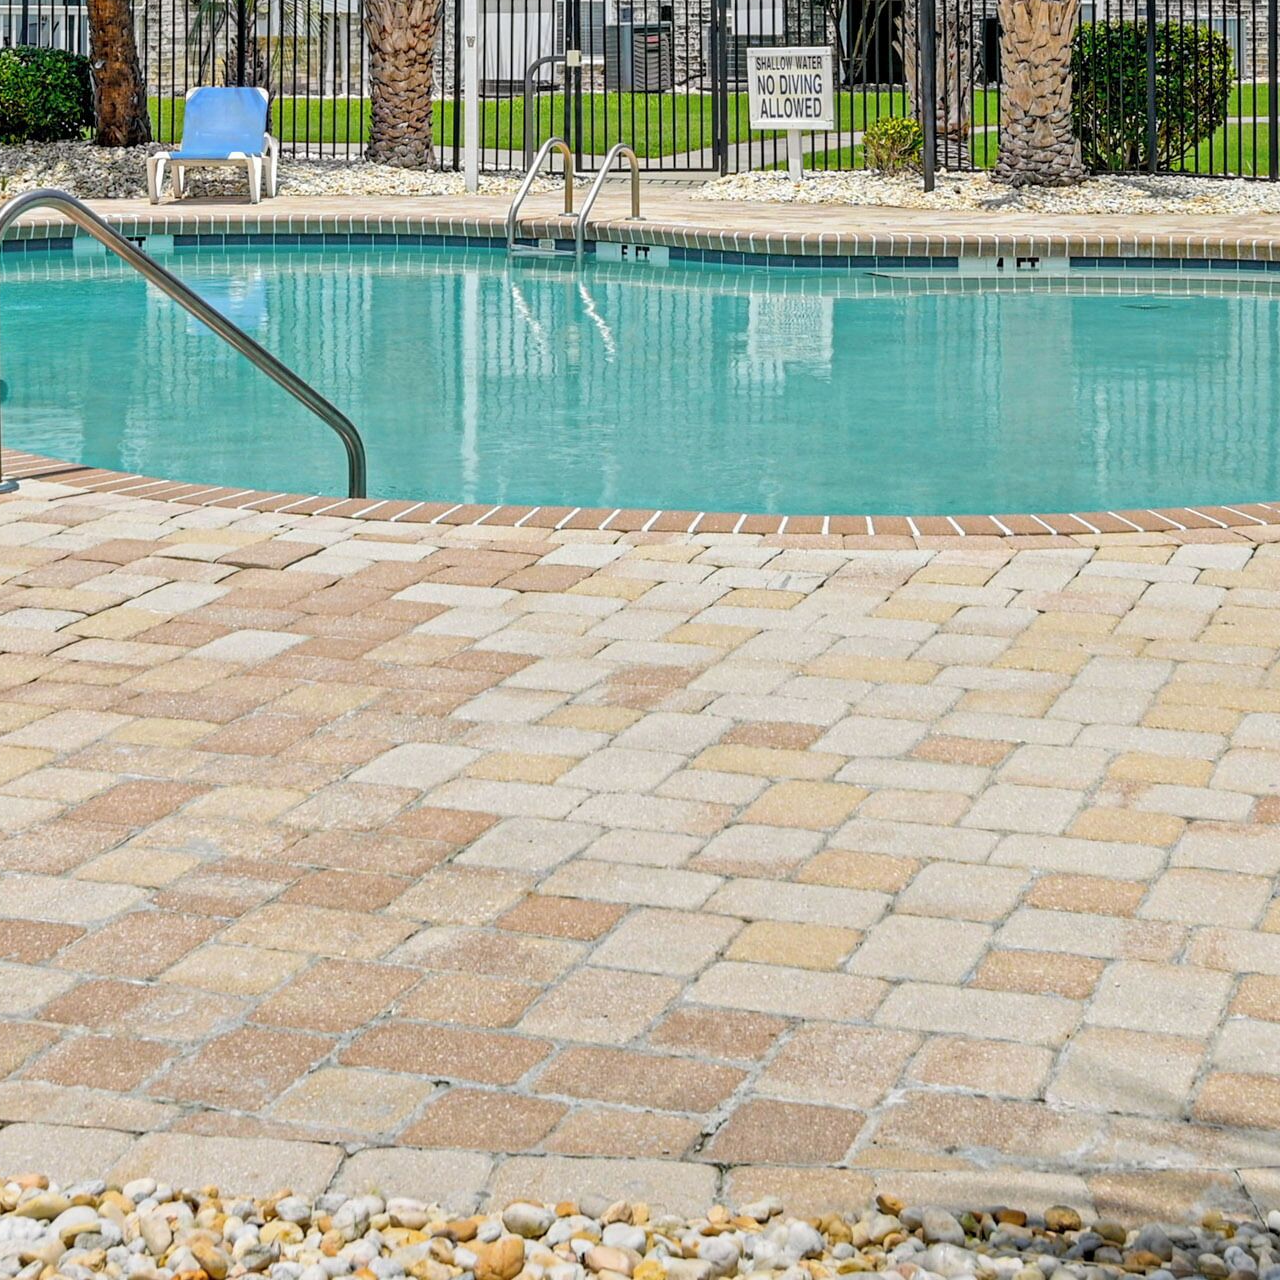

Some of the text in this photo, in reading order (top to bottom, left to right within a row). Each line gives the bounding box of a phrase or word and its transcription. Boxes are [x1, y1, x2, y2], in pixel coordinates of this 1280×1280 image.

[755, 55, 823, 71] SHALLOW WATER
[757, 74, 823, 95] NO DIVING
[760, 97, 822, 119] ALLOWED
